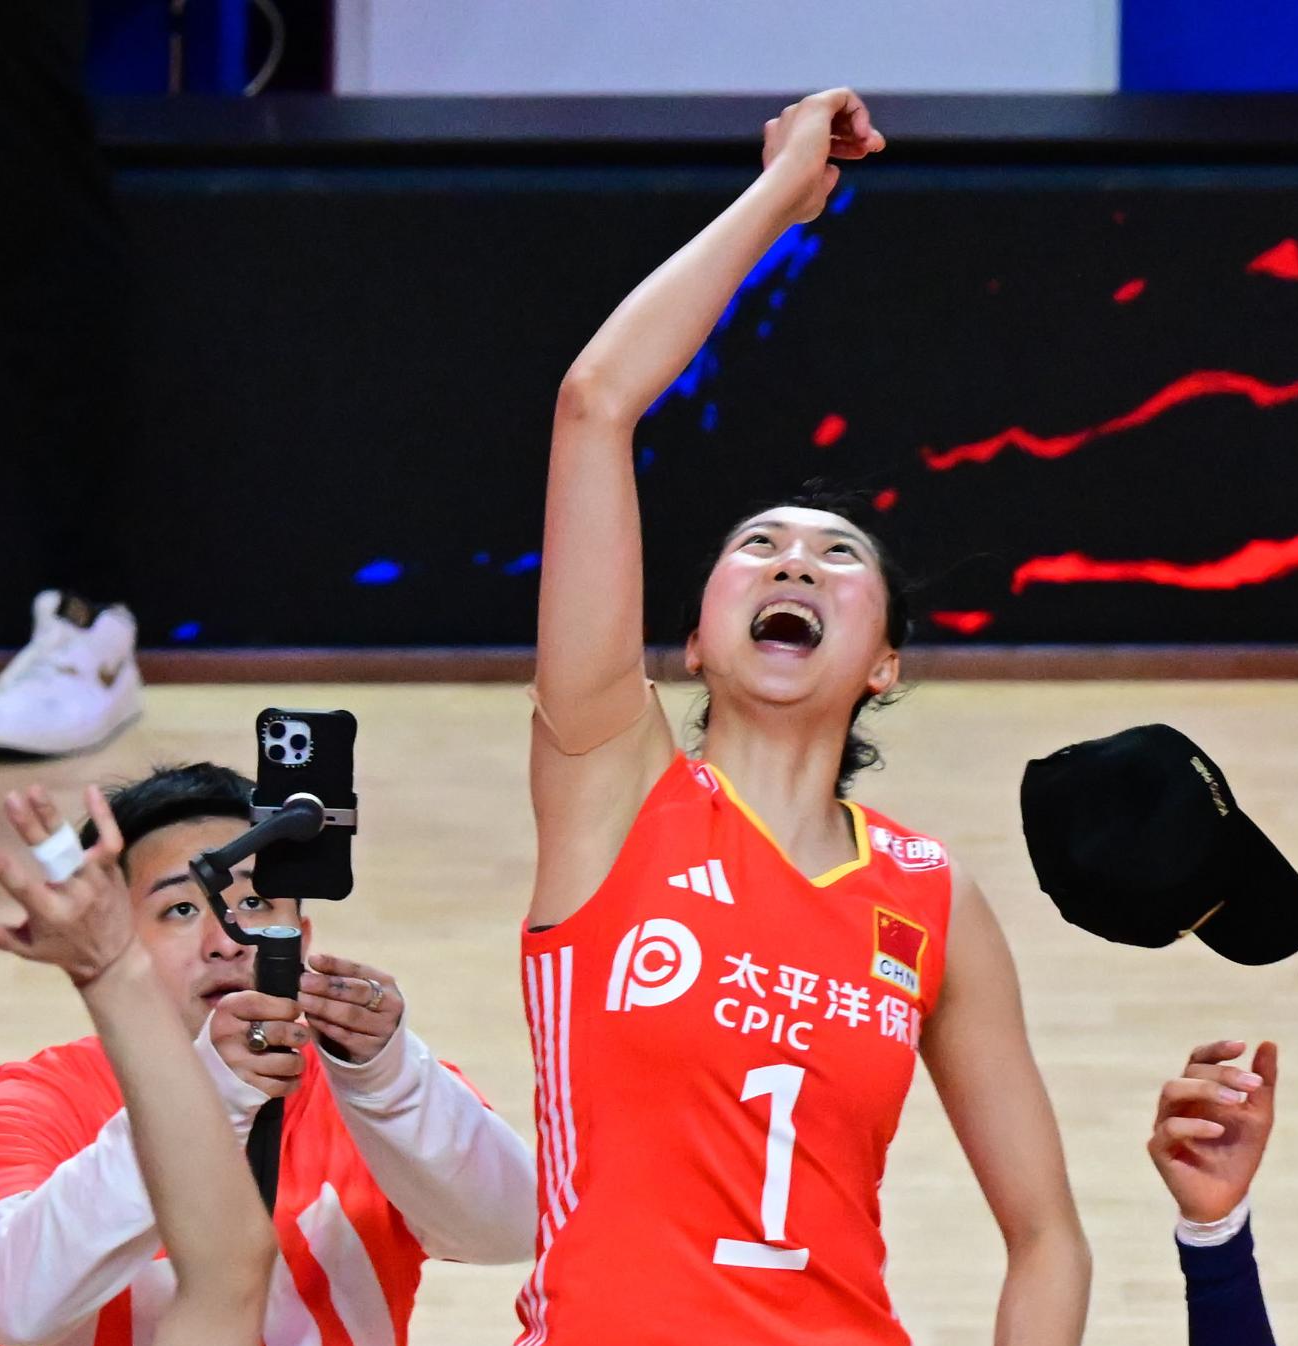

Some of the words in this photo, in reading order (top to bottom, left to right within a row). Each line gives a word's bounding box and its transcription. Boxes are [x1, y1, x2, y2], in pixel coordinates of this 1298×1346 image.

[718, 952, 922, 1050] 太平洋保
[878, 959, 917, 990] CHN
[713, 997, 814, 1051] CPIC
[712, 1063, 810, 1271] 1
